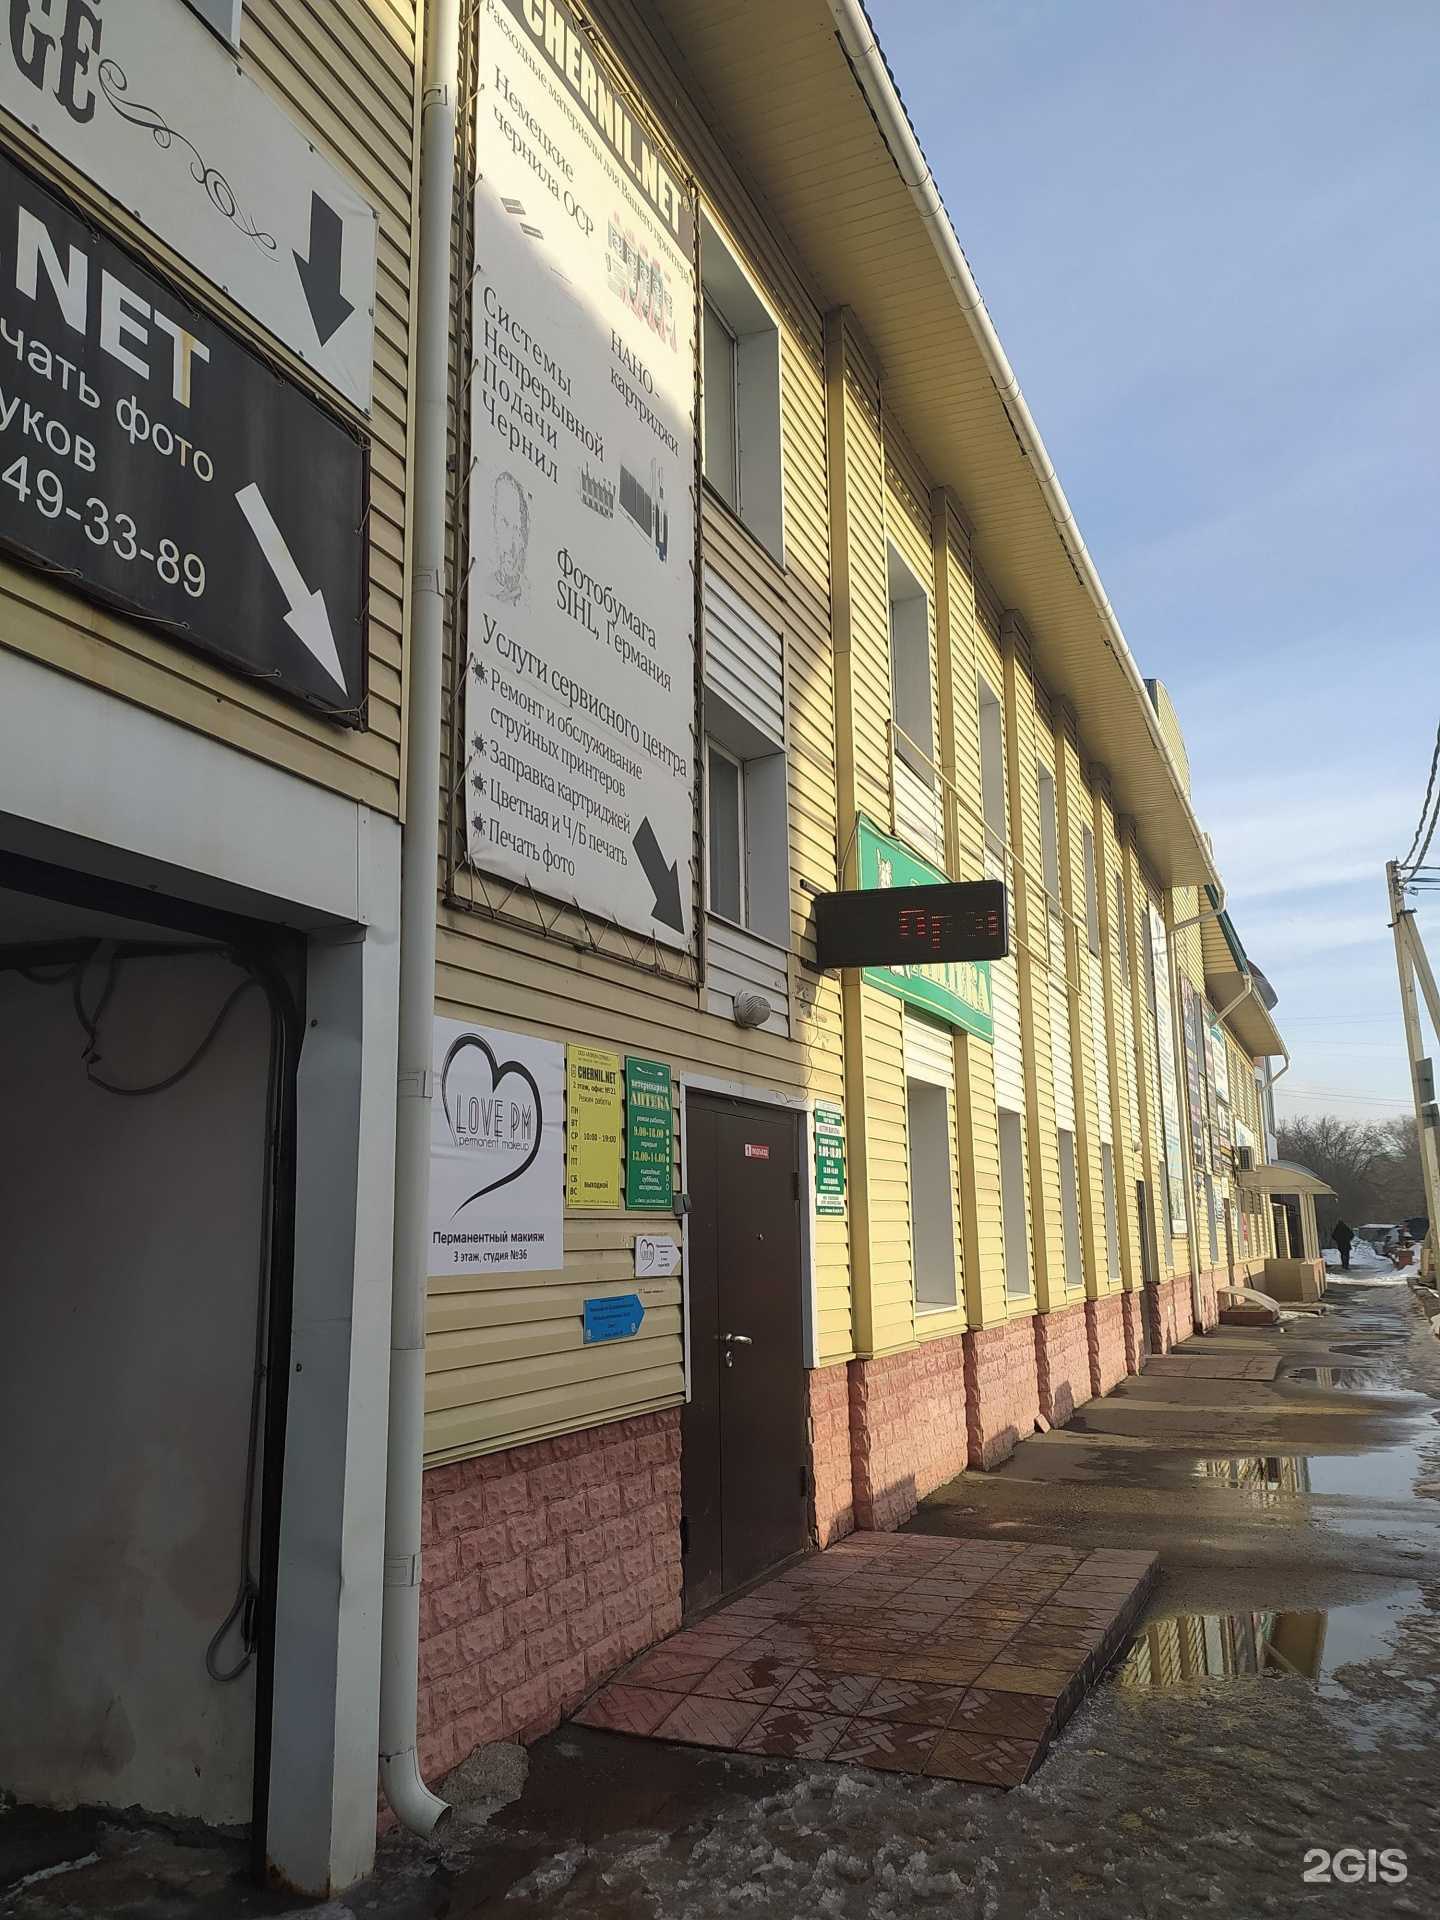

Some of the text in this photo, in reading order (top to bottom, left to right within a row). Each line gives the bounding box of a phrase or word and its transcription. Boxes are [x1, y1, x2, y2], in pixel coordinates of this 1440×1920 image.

[493, 103, 561, 201] чернила
[494, 63, 575, 184] Немецкие
[548, 82, 604, 165] материалы
[603, 158, 620, 186] для
[621, 179, 653, 233] Вашего
[15, 205, 210, 408] NET
[484, 286, 572, 398] Системы
[0, 316, 214, 483] чать фото
[482, 354, 558, 450] Подачи
[484, 319, 604, 463] Непрерывной
[610, 328, 661, 399] НАНО-
[0, 385, 97, 472] уков
[482, 389, 559, 485] Чернил
[609, 367, 680, 458] картриджи
[1, 455, 208, 598] 49-33-89
[556, 579, 672, 693] SIHL, Германия
[557, 547, 657, 650] Фотобумага
[483, 612, 687, 778] Услуги сервисного центра
[490, 667, 643, 781] Ремонт и обслуживание
[489, 739, 631, 836] Заправка картриджей
[490, 707, 626, 799] струйных принтеров
[488, 817, 576, 878] Печать фото
[489, 777, 629, 868] Цветная и Ч/Б печать
[456, 1092, 504, 1138] LOVE
[570, 1106, 579, 1115] ПН
[578, 1065, 616, 1085] CHERNIL.NET
[458, 1135, 529, 1151] permanent makeup
[570, 1119, 578, 1128] ВТ
[570, 1132, 579, 1141] СР
[570, 1144, 578, 1153] ЧТ
[569, 1187, 578, 1196] ВС
[570, 1174, 578, 1183] СБ
[432, 1230, 545, 1246] Перманентный макияж
[453, 1249, 528, 1265] 3 этаж, студия №36
